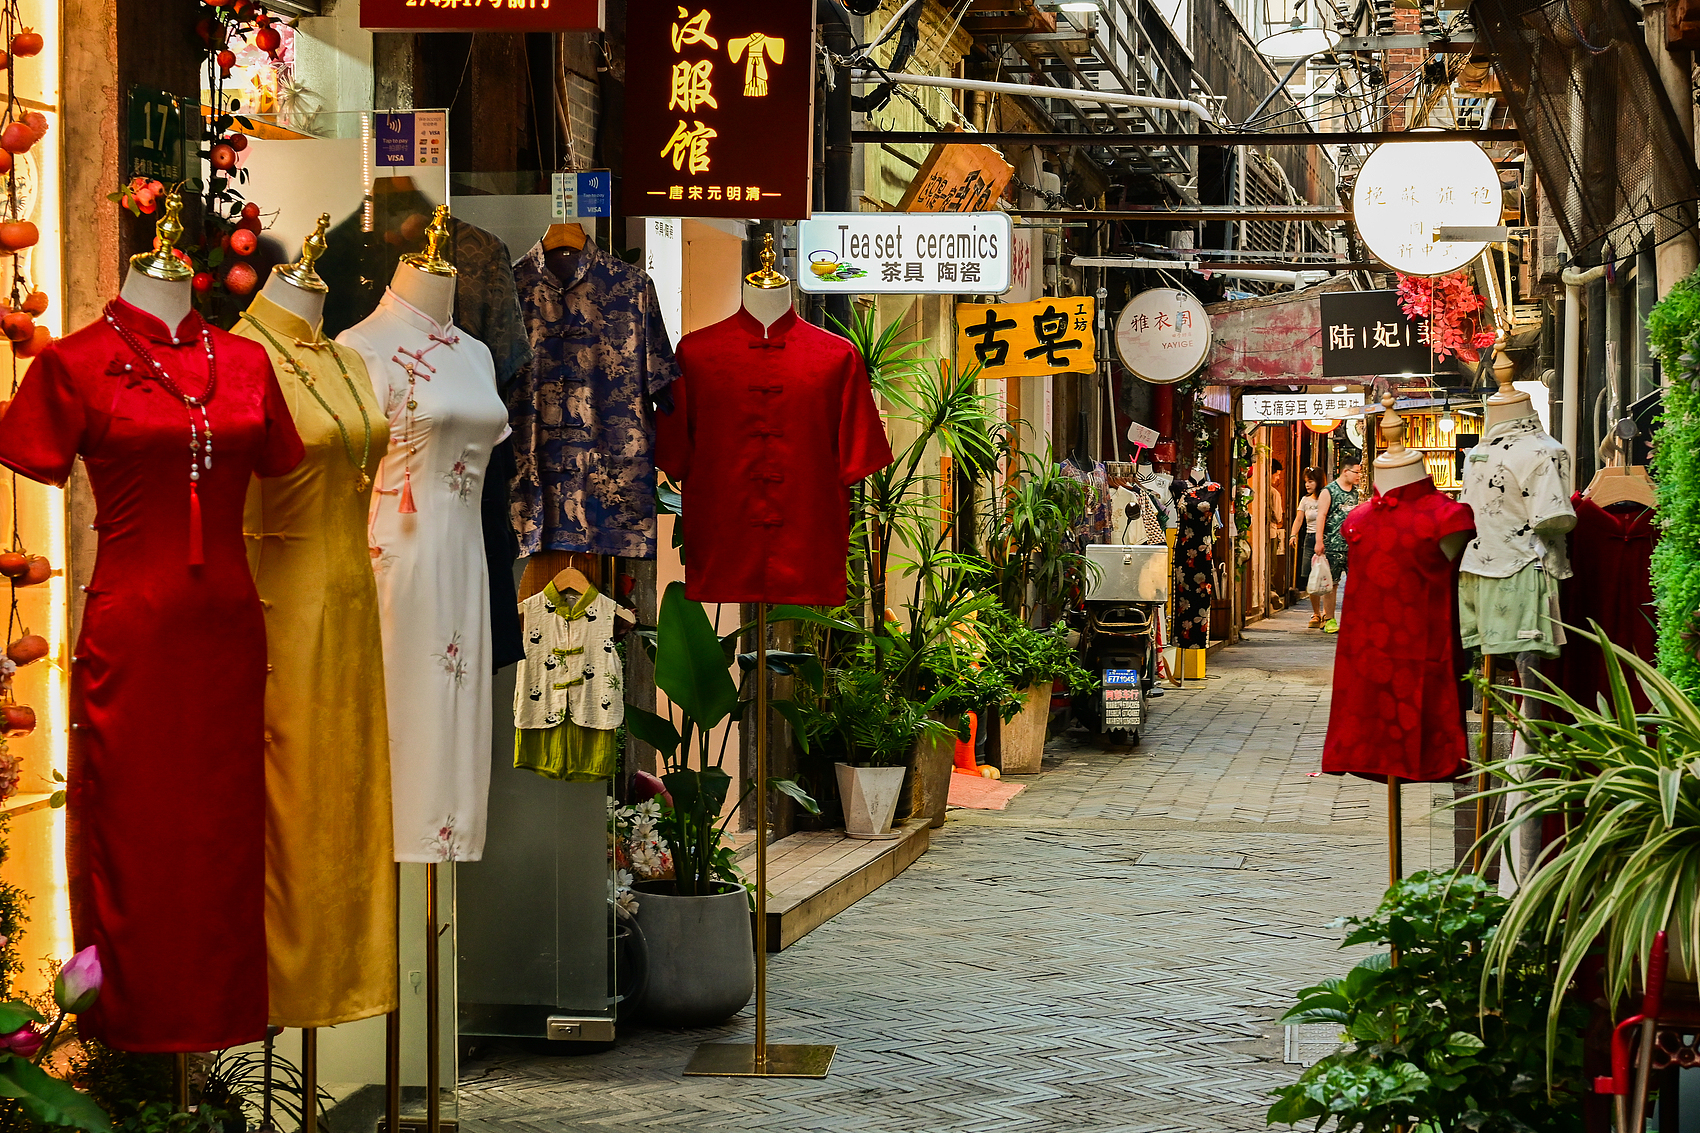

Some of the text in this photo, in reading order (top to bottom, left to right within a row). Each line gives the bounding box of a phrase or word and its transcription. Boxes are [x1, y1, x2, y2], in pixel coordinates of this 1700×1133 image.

[660, 5, 718, 175] 汉服馆
[143, 101, 168, 151] 17
[838, 225, 998, 259] Tea set ceramics
[881, 262, 981, 283] 茶具 陶瓷
[1074, 304, 1088, 332] 工坊
[964, 305, 1083, 369] 古皂
[1161, 340, 1194, 349] YAYIGE
[1261, 400, 1307, 416] 无痛穿耳
